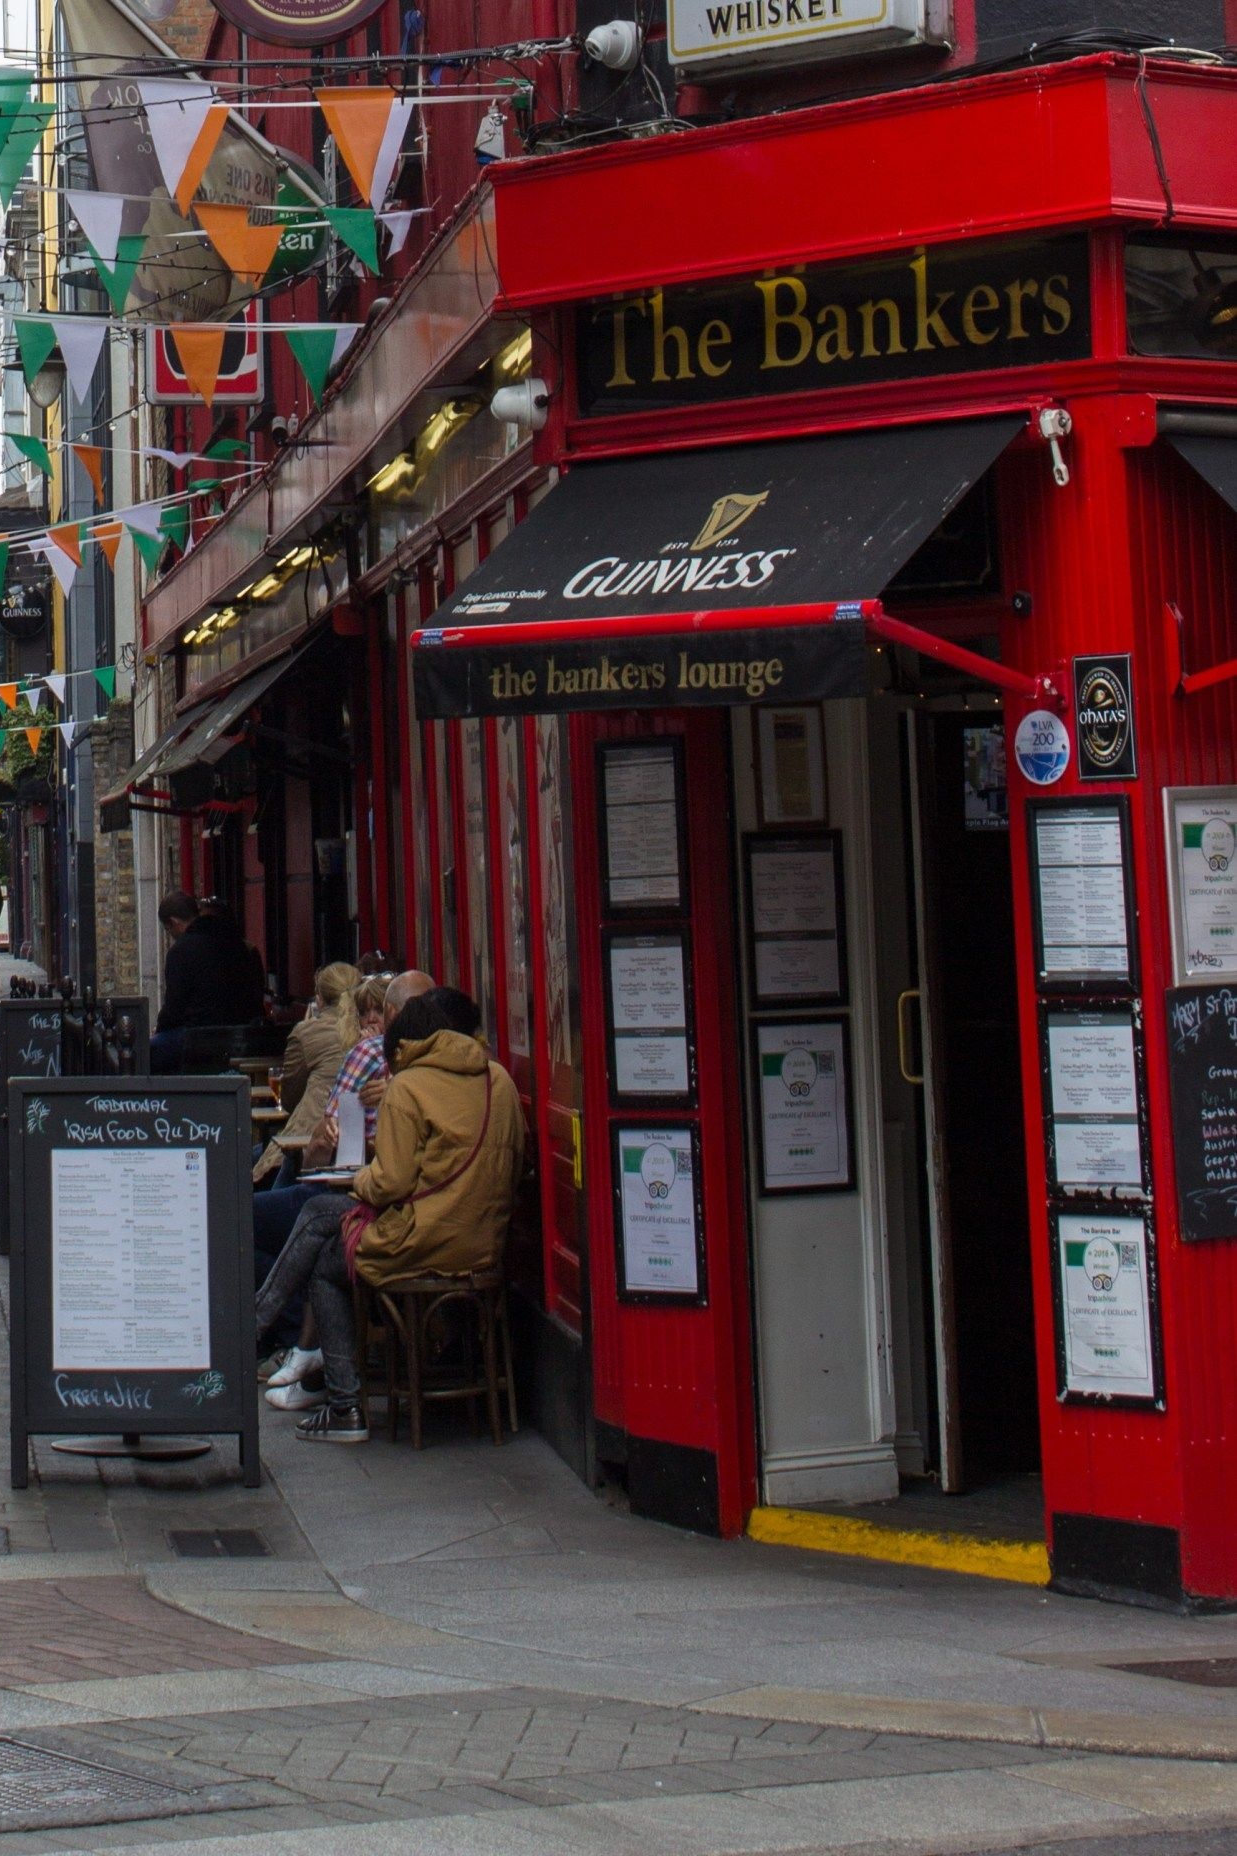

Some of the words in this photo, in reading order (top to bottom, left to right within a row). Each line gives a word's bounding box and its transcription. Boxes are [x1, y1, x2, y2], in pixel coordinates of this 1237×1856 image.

[593, 286, 732, 388] The
[755, 252, 1072, 370] Bankers
[563, 548, 790, 599] GUINNESS
[3, 607, 42, 618] GUINNESS
[490, 657, 537, 699] the
[546, 655, 666, 695] bankers
[677, 651, 784, 695] lounge
[1038, 721, 1054, 730] LVA
[1033, 733, 1055, 746] 200
[107, 1120, 149, 1142] FOOD
[182, 1118, 222, 1144] DAY
[1107, 1308, 1138, 1316] EXCELLENCE
